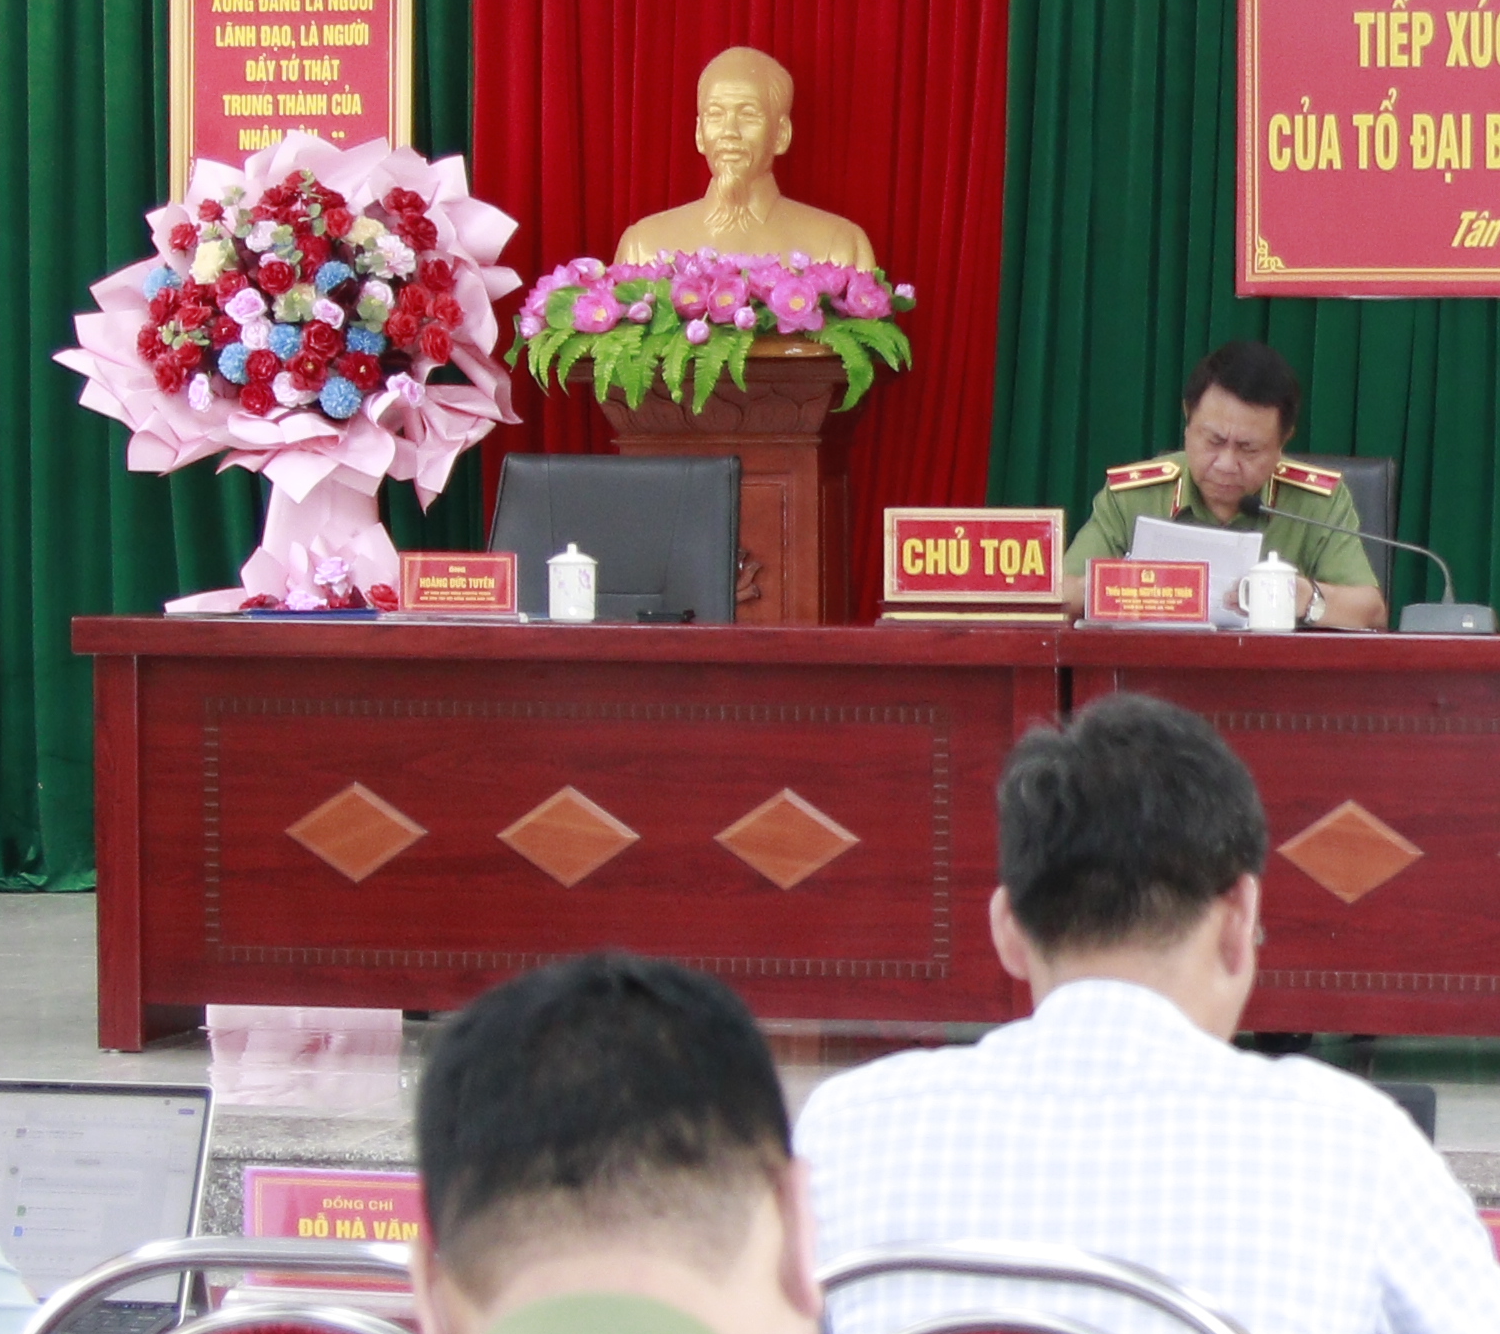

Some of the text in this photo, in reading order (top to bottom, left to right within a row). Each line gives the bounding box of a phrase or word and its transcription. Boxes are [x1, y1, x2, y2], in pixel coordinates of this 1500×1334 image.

[216, 19, 368, 51] LÃNH ĐẠO, LÀ NGƯỜI
[280, 54, 300, 81] TỚ
[303, 55, 340, 85] THẬT
[223, 85, 362, 116] TRUNG THÀNH CỦA
[1268, 95, 1342, 172] CỦA
[1352, 87, 1399, 171] TỔ
[1409, 113, 1472, 184] ĐẠI
[902, 525, 1046, 585] CHỦ TỌA
[336, 1217, 366, 1239] HÀ
